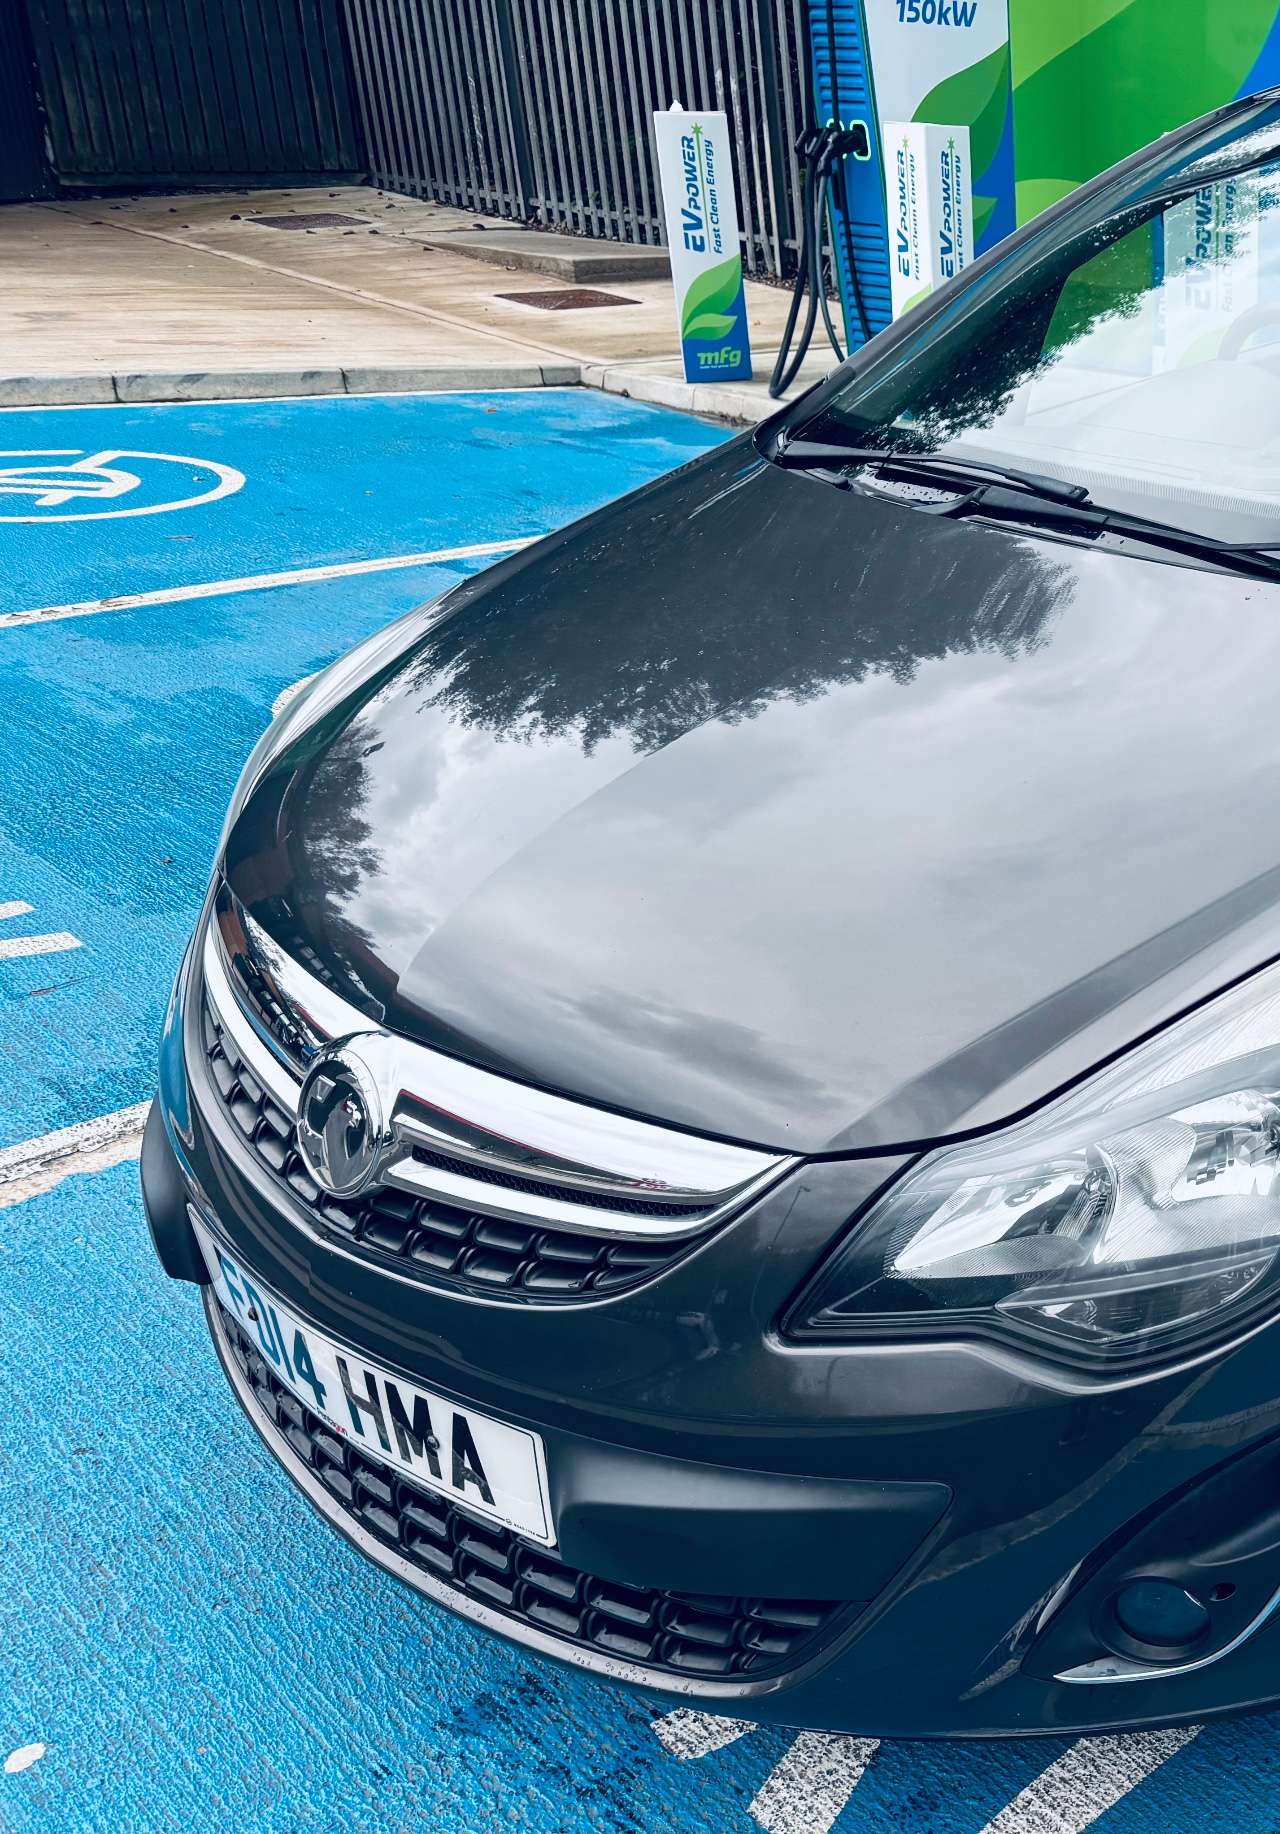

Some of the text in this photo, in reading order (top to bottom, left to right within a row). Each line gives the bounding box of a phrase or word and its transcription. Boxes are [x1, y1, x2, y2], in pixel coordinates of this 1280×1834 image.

[896, 0, 977, 27] 150kW
[704, 139, 723, 254] Fast Clean Energy
[697, 346, 741, 369] mfg
[335, 1355, 496, 1507] HMA
